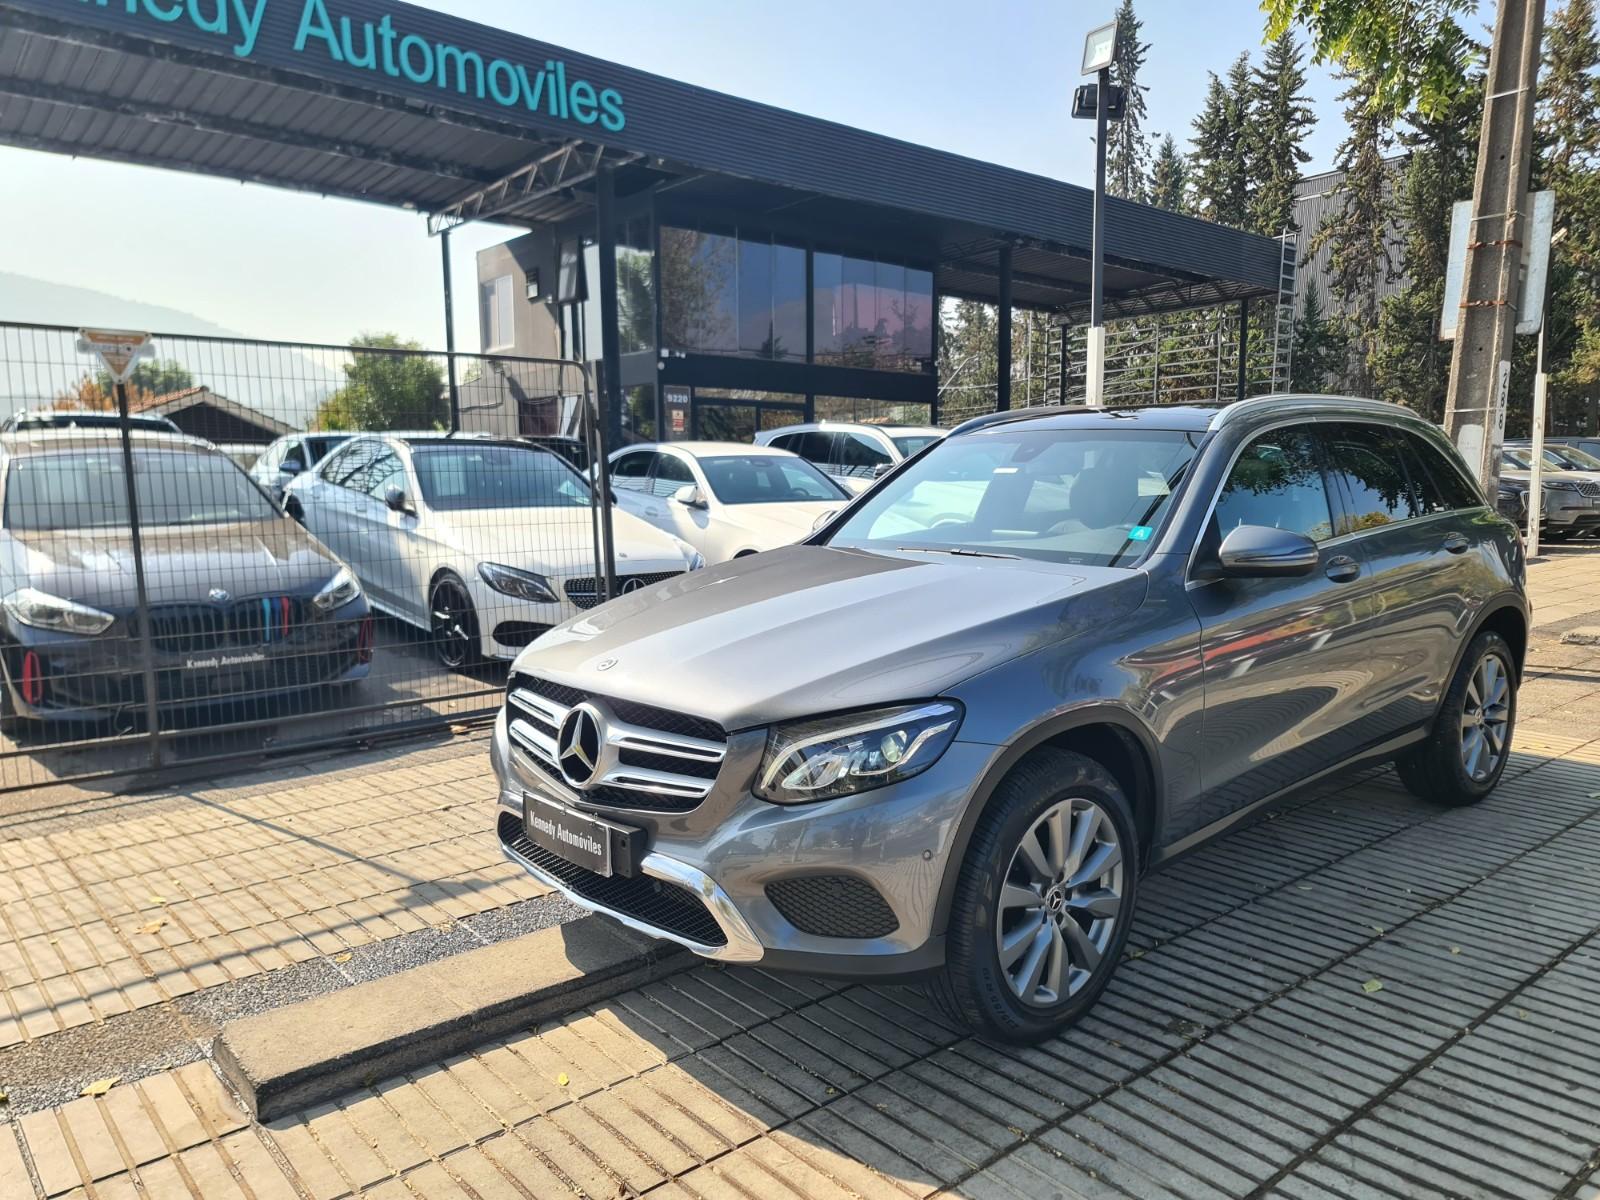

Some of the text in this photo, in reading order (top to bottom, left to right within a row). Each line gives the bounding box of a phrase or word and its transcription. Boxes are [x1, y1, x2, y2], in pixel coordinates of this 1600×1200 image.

[294, 0, 626, 132] Automoviles
[530, 810, 602, 856] Kennedy Automóviles
